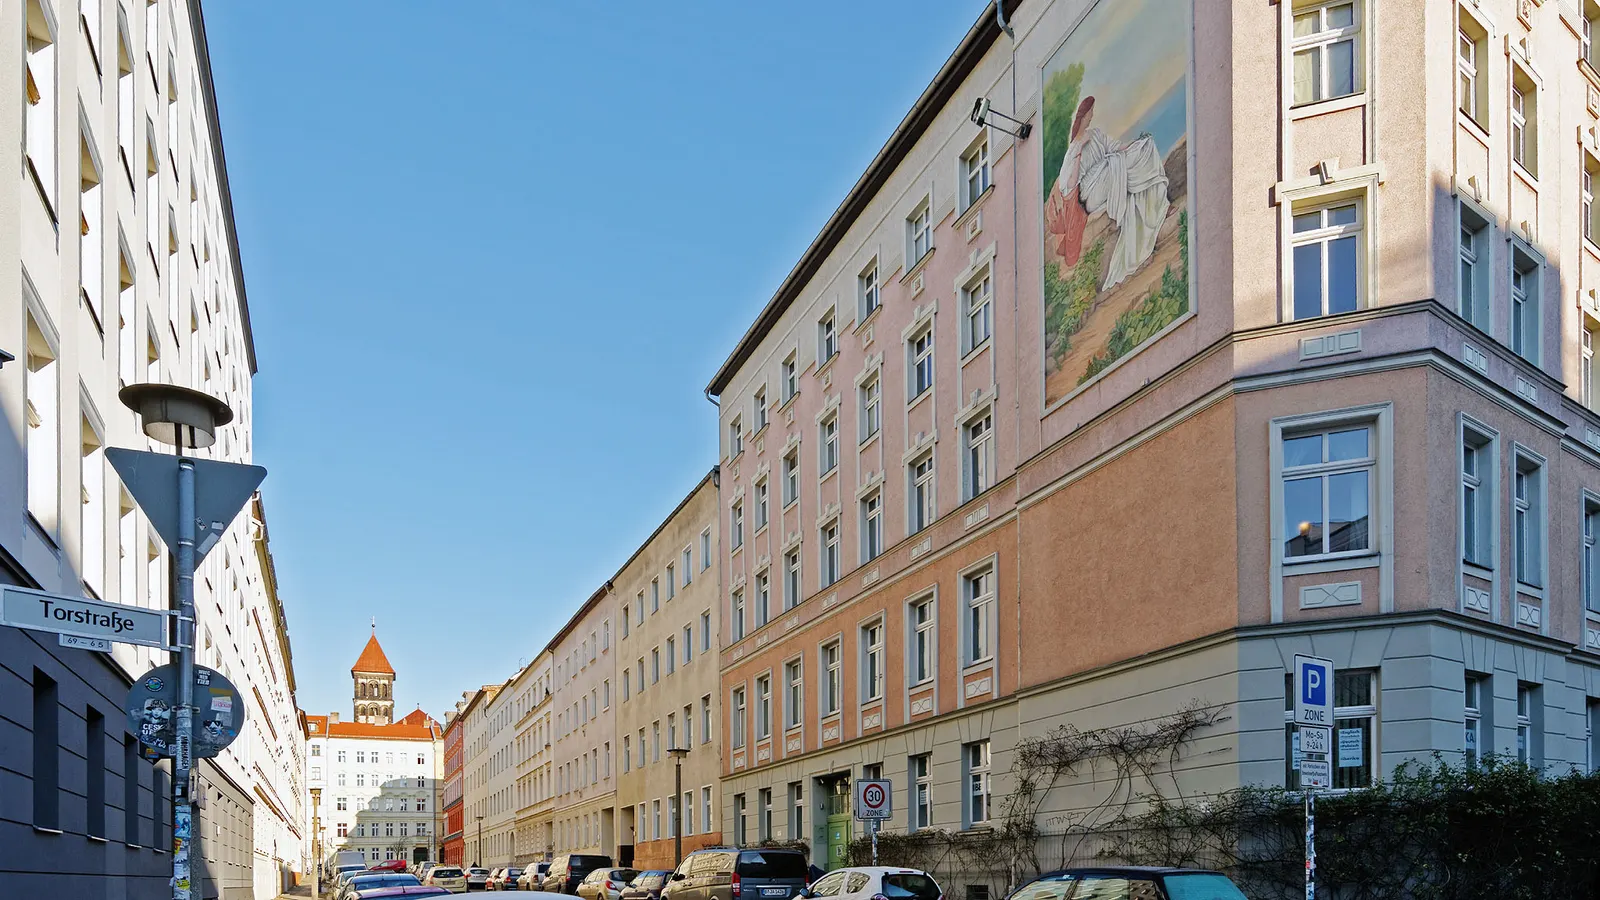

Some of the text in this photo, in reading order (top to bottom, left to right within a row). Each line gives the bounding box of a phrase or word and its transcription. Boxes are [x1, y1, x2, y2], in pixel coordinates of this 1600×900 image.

[39, 599, 134, 632] Torstraße
[1308, 669, 1320, 699] P
[1304, 709, 1325, 722] ZONE
[1305, 730, 1324, 740] Mo-Sa
[867, 790, 881, 802] 30
